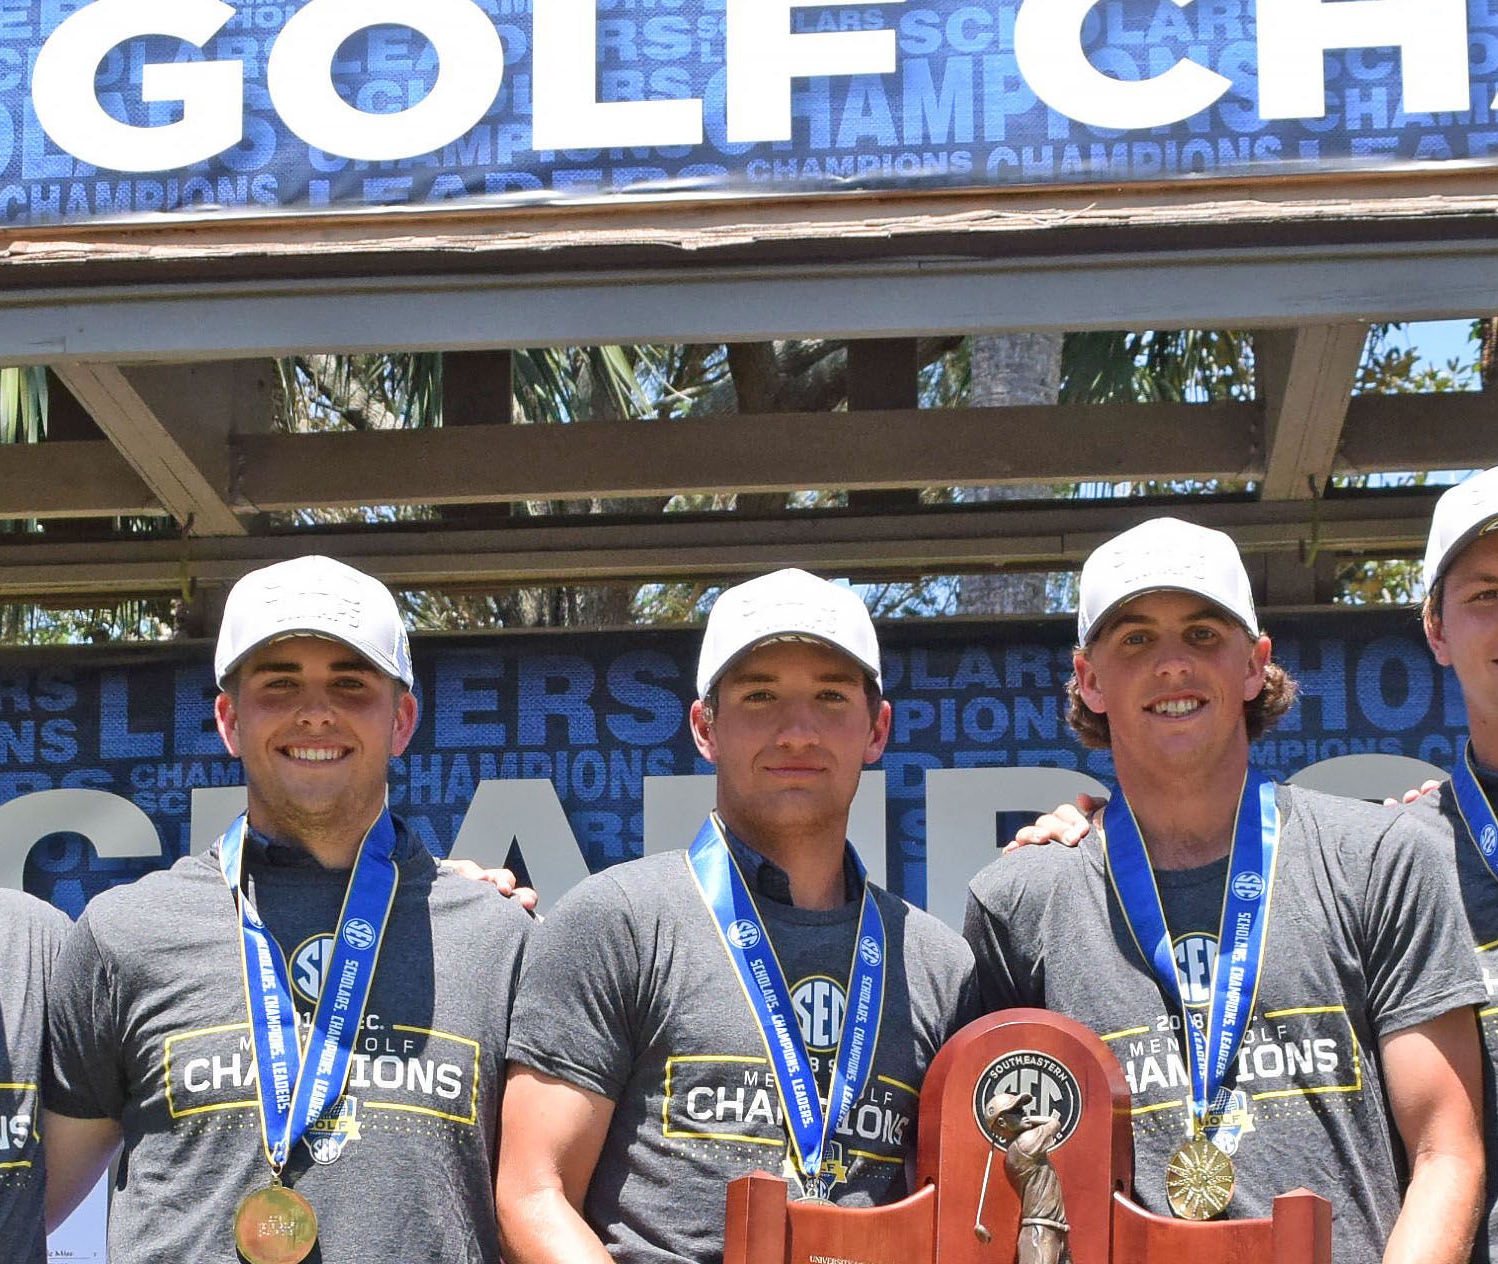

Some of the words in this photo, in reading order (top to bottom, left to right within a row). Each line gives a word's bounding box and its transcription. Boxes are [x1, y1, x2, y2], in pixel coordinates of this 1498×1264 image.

[32, 0, 898, 172] GOLF
[746, 151, 973, 184] CHAMPIONS
[1234, 874, 1264, 900] SEC
[346, 921, 374, 948] SEC
[1230, 912, 1251, 964] SCHOLARS.
[332, 959, 359, 1012] SCHOLARS.
[855, 975, 873, 1024] SCHOLARS.
[1222, 967, 1245, 1027] CHAMPIONS.
[315, 1015, 345, 1077] CHAMPIONS.
[365, 1038, 415, 1052] OLF
[750, 959, 780, 1013] SCHOLARS.
[771, 1014, 800, 1077] CHAMPIONS.
[792, 1078, 814, 1129] LEADERS.
[845, 1027, 866, 1084] CHAMPIONS.
[1215, 1030, 1233, 1078] LEADERS.
[1243, 1025, 1287, 1045] OLF
[272, 1062, 290, 1114] LEADERS.
[989, 1055, 1069, 1083] SOUTHEASTERN
